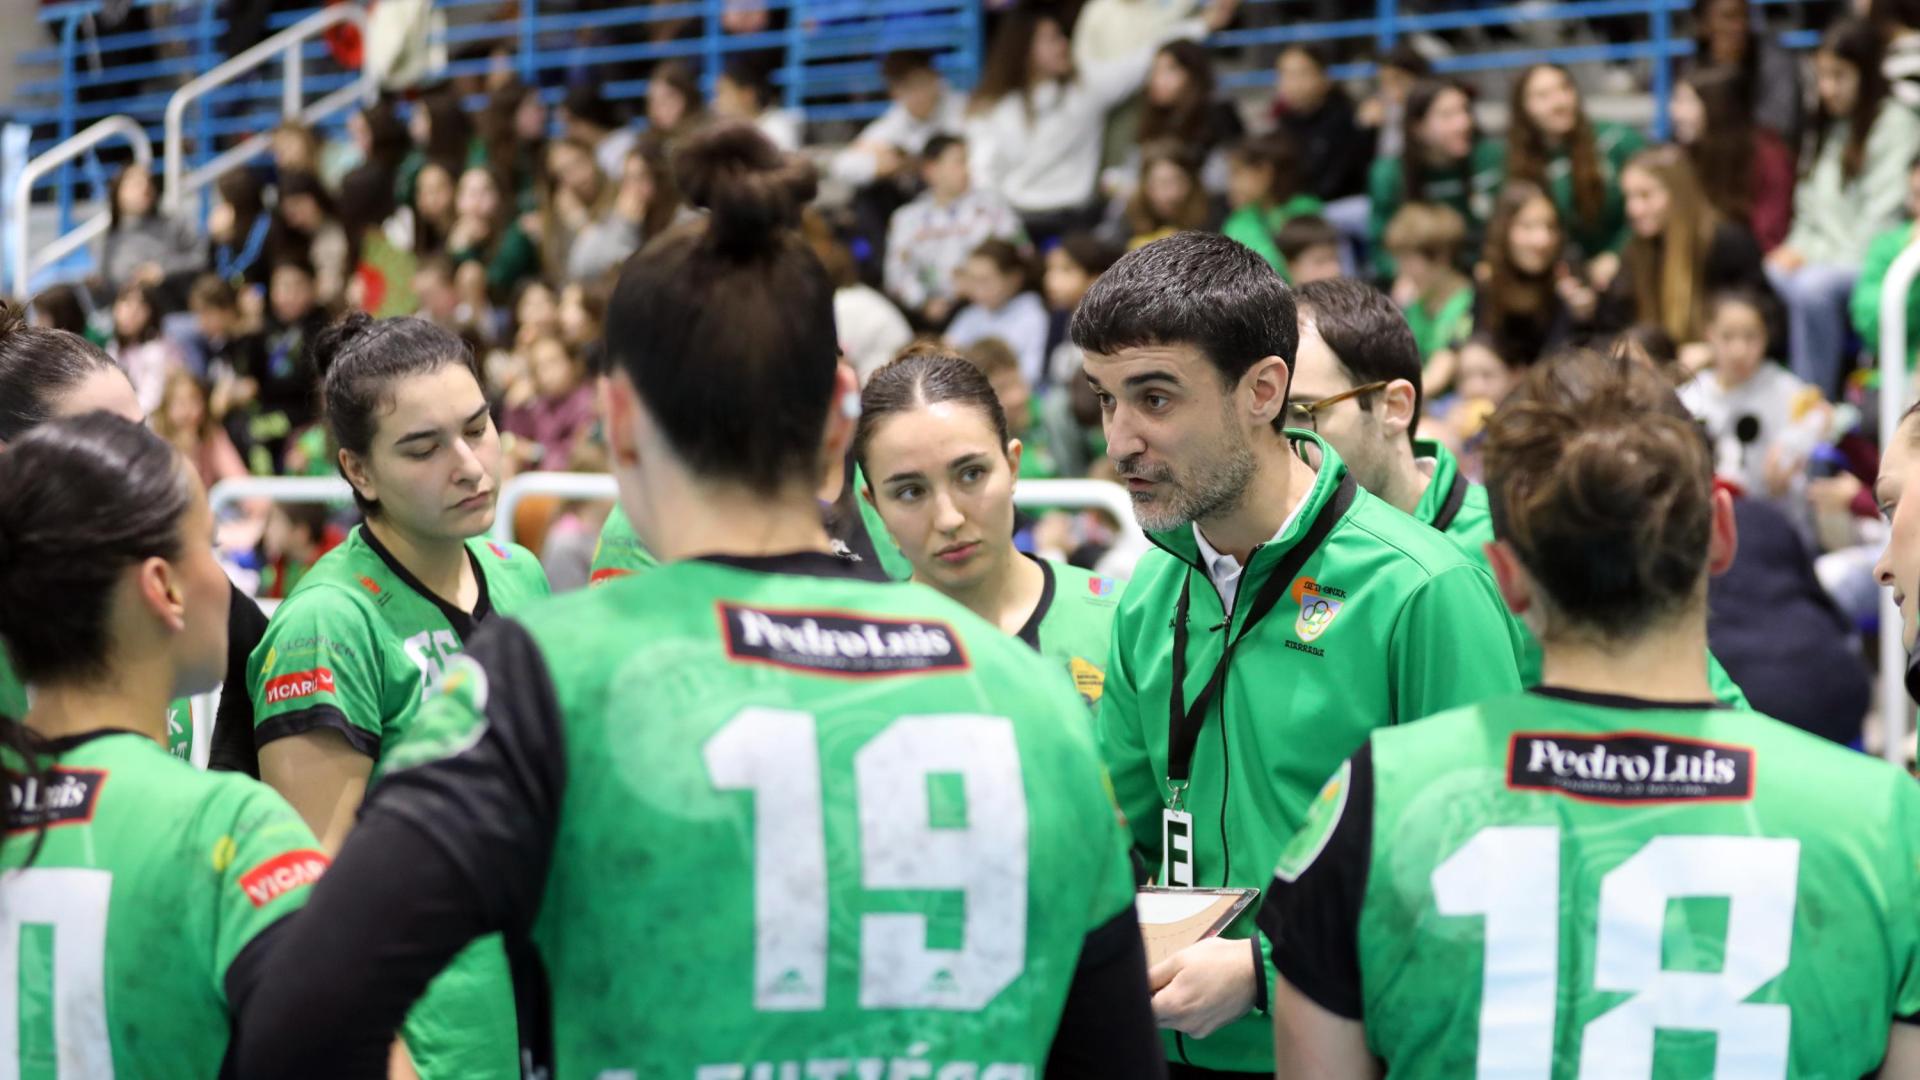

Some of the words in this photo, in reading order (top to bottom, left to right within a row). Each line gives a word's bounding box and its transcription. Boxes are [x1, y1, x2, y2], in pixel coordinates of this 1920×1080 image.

[1526, 738, 1736, 784] PedroLuis
[704, 706, 1029, 1012] 19
[1167, 819, 1189, 888] E
[1430, 826, 1801, 1080] 18
